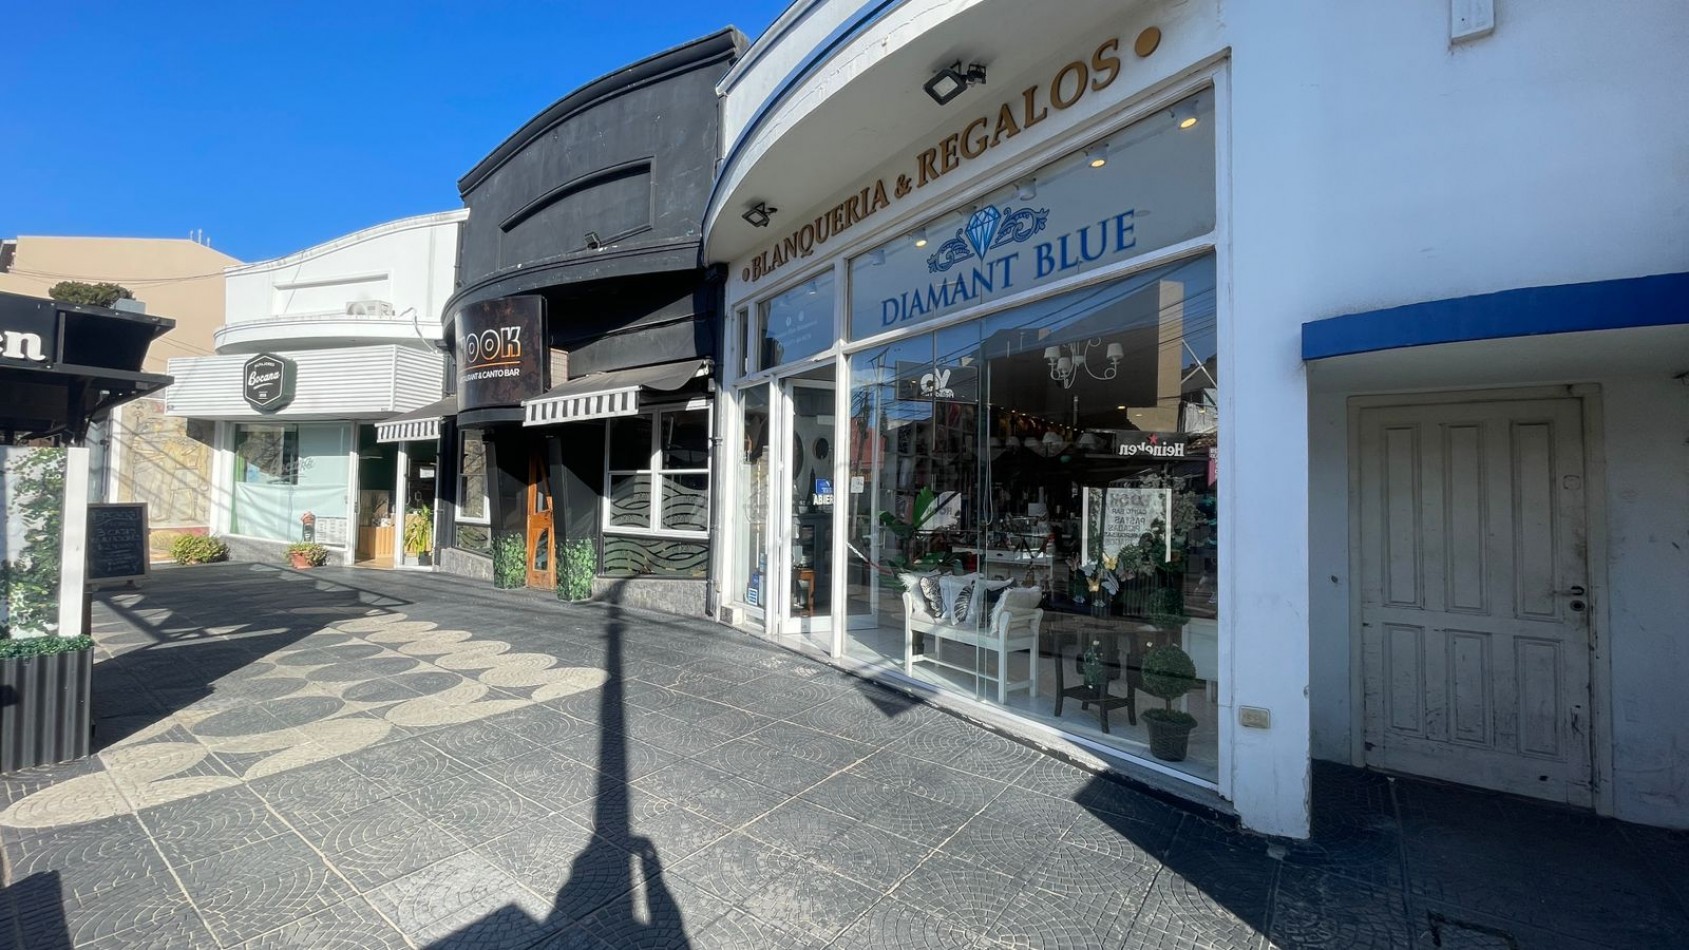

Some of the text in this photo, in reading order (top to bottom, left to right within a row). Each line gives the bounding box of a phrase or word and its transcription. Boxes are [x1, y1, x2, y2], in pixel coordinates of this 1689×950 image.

[750, 38, 1121, 283] BLANQUERIA & REGALOS
[881, 208, 1136, 327] DIAMANT BLUE
[248, 371, 281, 386] Bocana
[482, 369, 504, 379] CANTO
[504, 367, 520, 377] BAR
